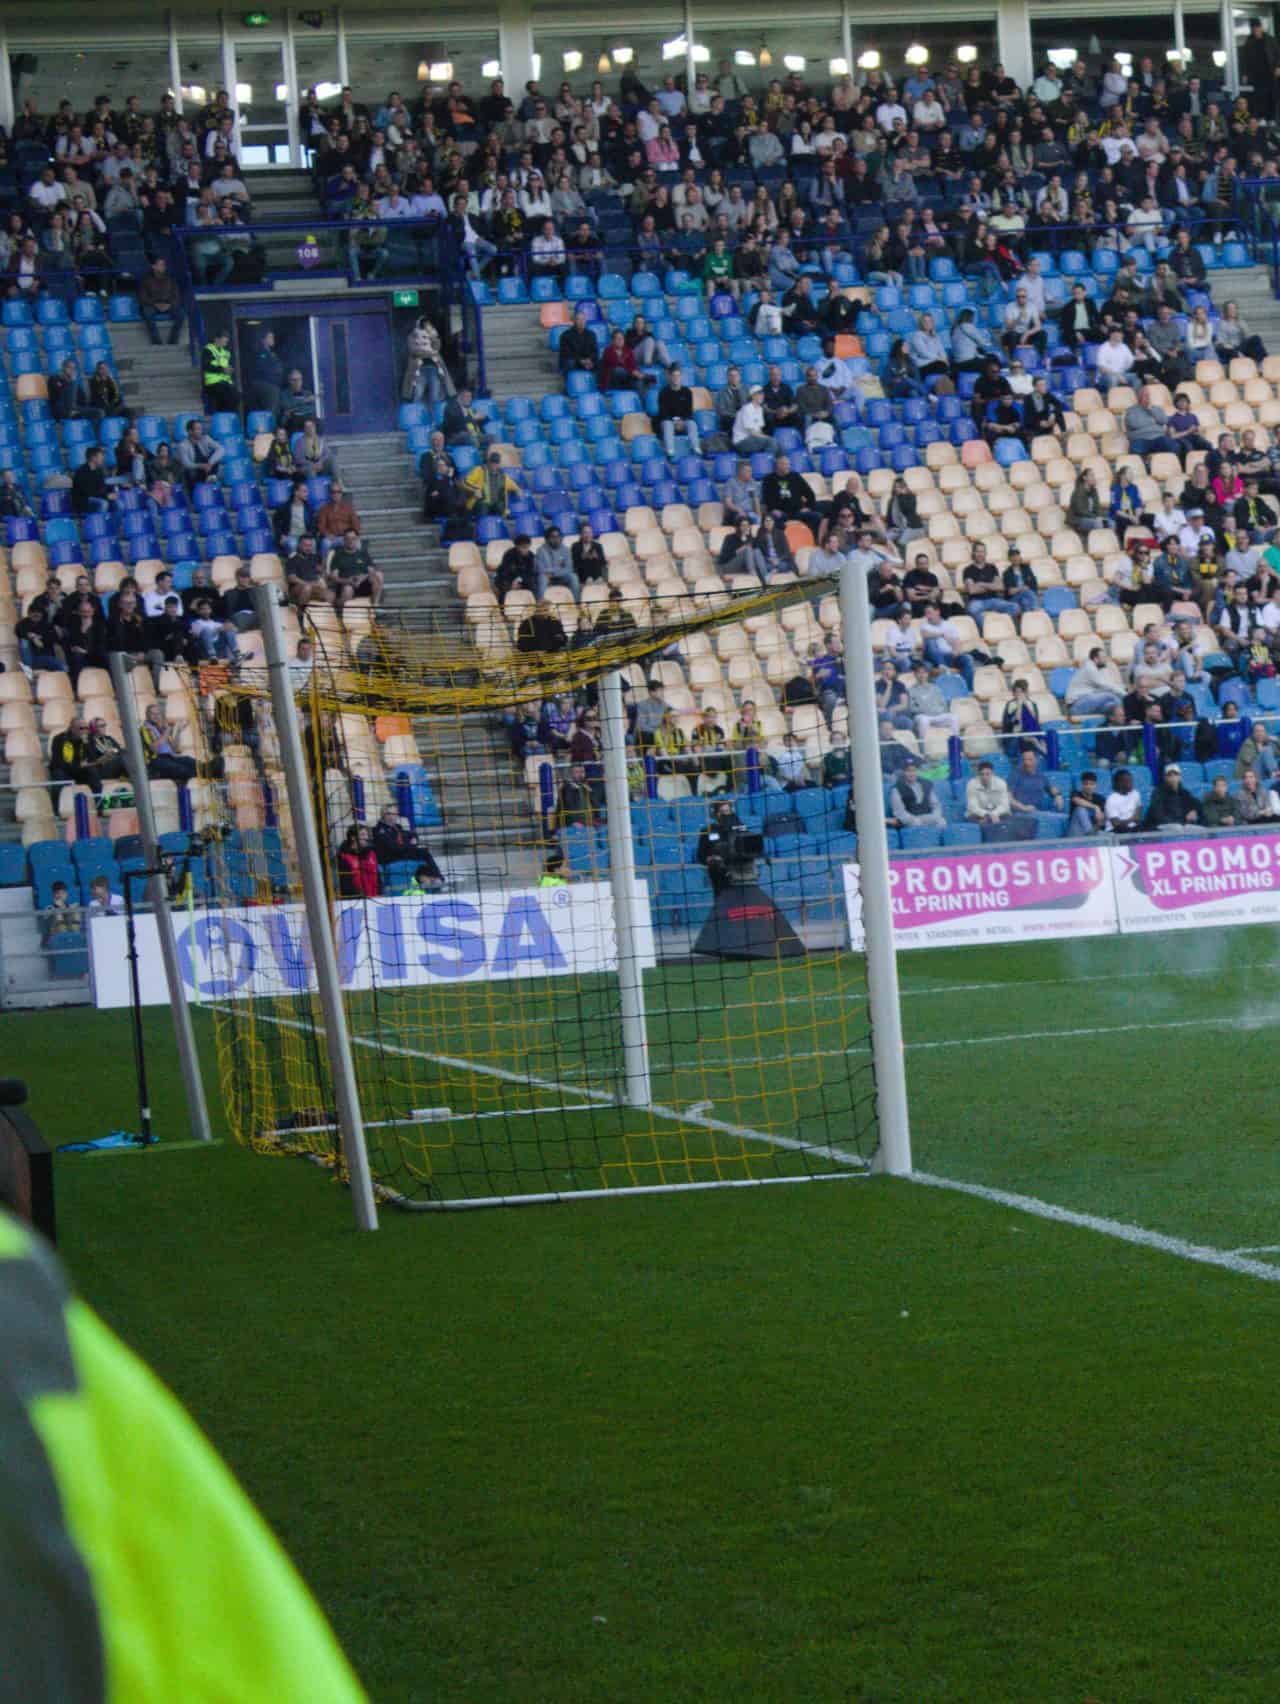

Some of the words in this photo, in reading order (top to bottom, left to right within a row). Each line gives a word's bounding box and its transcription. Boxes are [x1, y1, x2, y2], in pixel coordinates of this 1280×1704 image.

[1151, 879, 1177, 897] XL
[1181, 870, 1274, 895] PRINTING
[915, 890, 1010, 913] PRINTING
